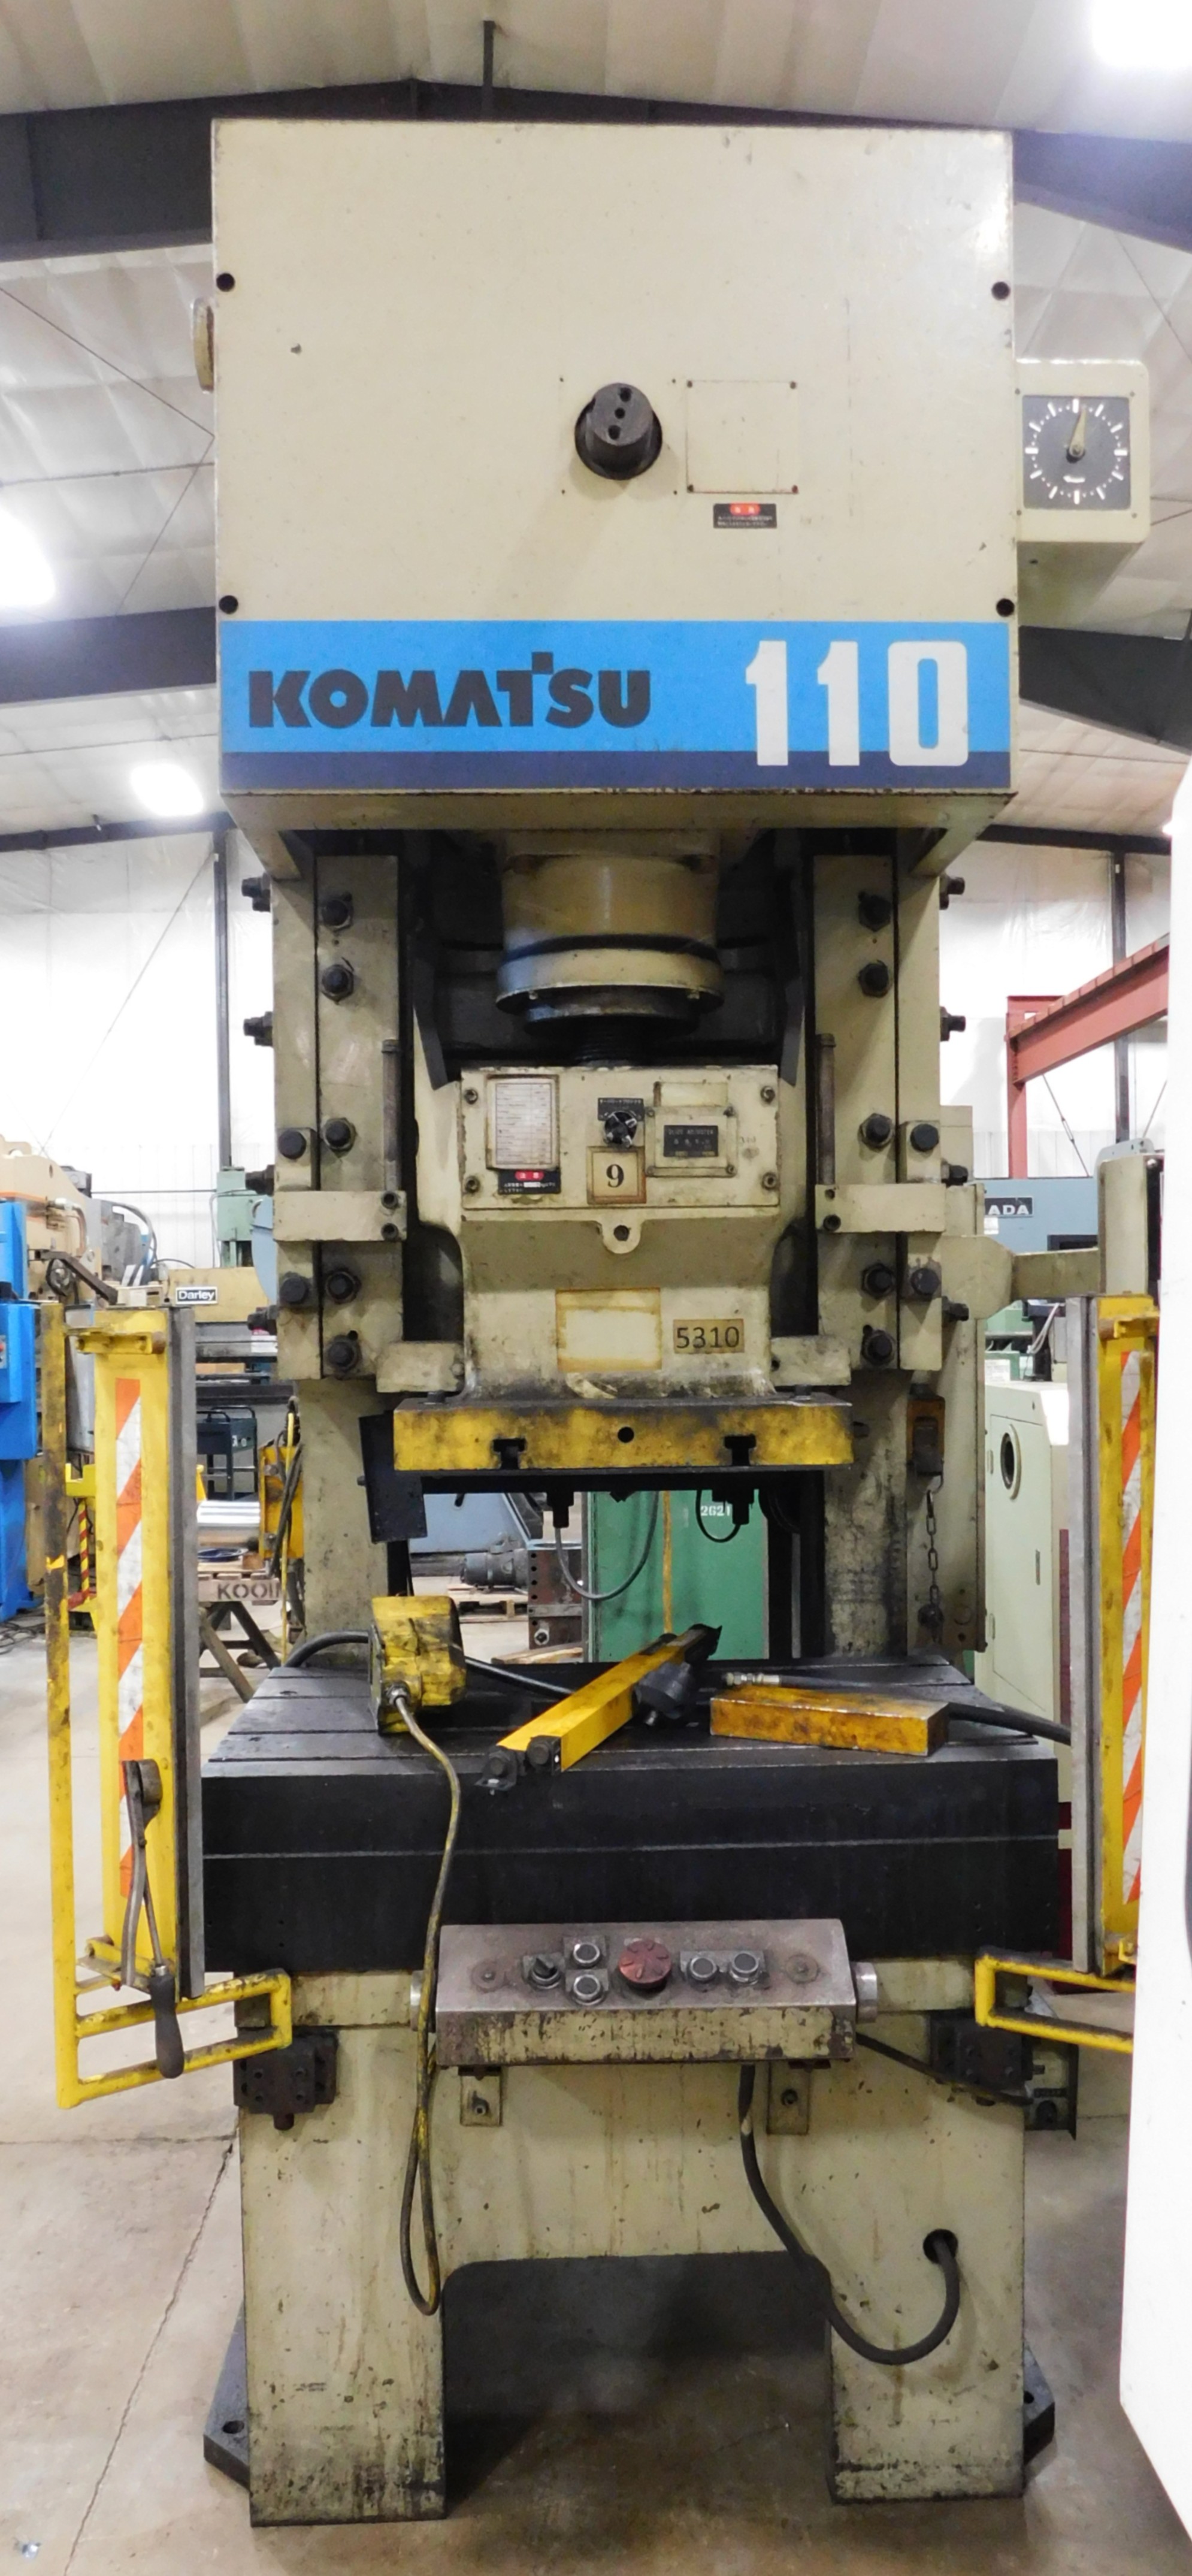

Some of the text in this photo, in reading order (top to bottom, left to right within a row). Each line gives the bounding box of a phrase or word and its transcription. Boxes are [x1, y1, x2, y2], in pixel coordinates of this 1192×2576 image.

[249, 640, 969, 766] KOMATSU 110
[606, 1164, 624, 1188] 9
[179, 1290, 215, 1301] Darley
[676, 1326, 740, 1349] 5310
[700, 1505, 730, 1516] 2621
